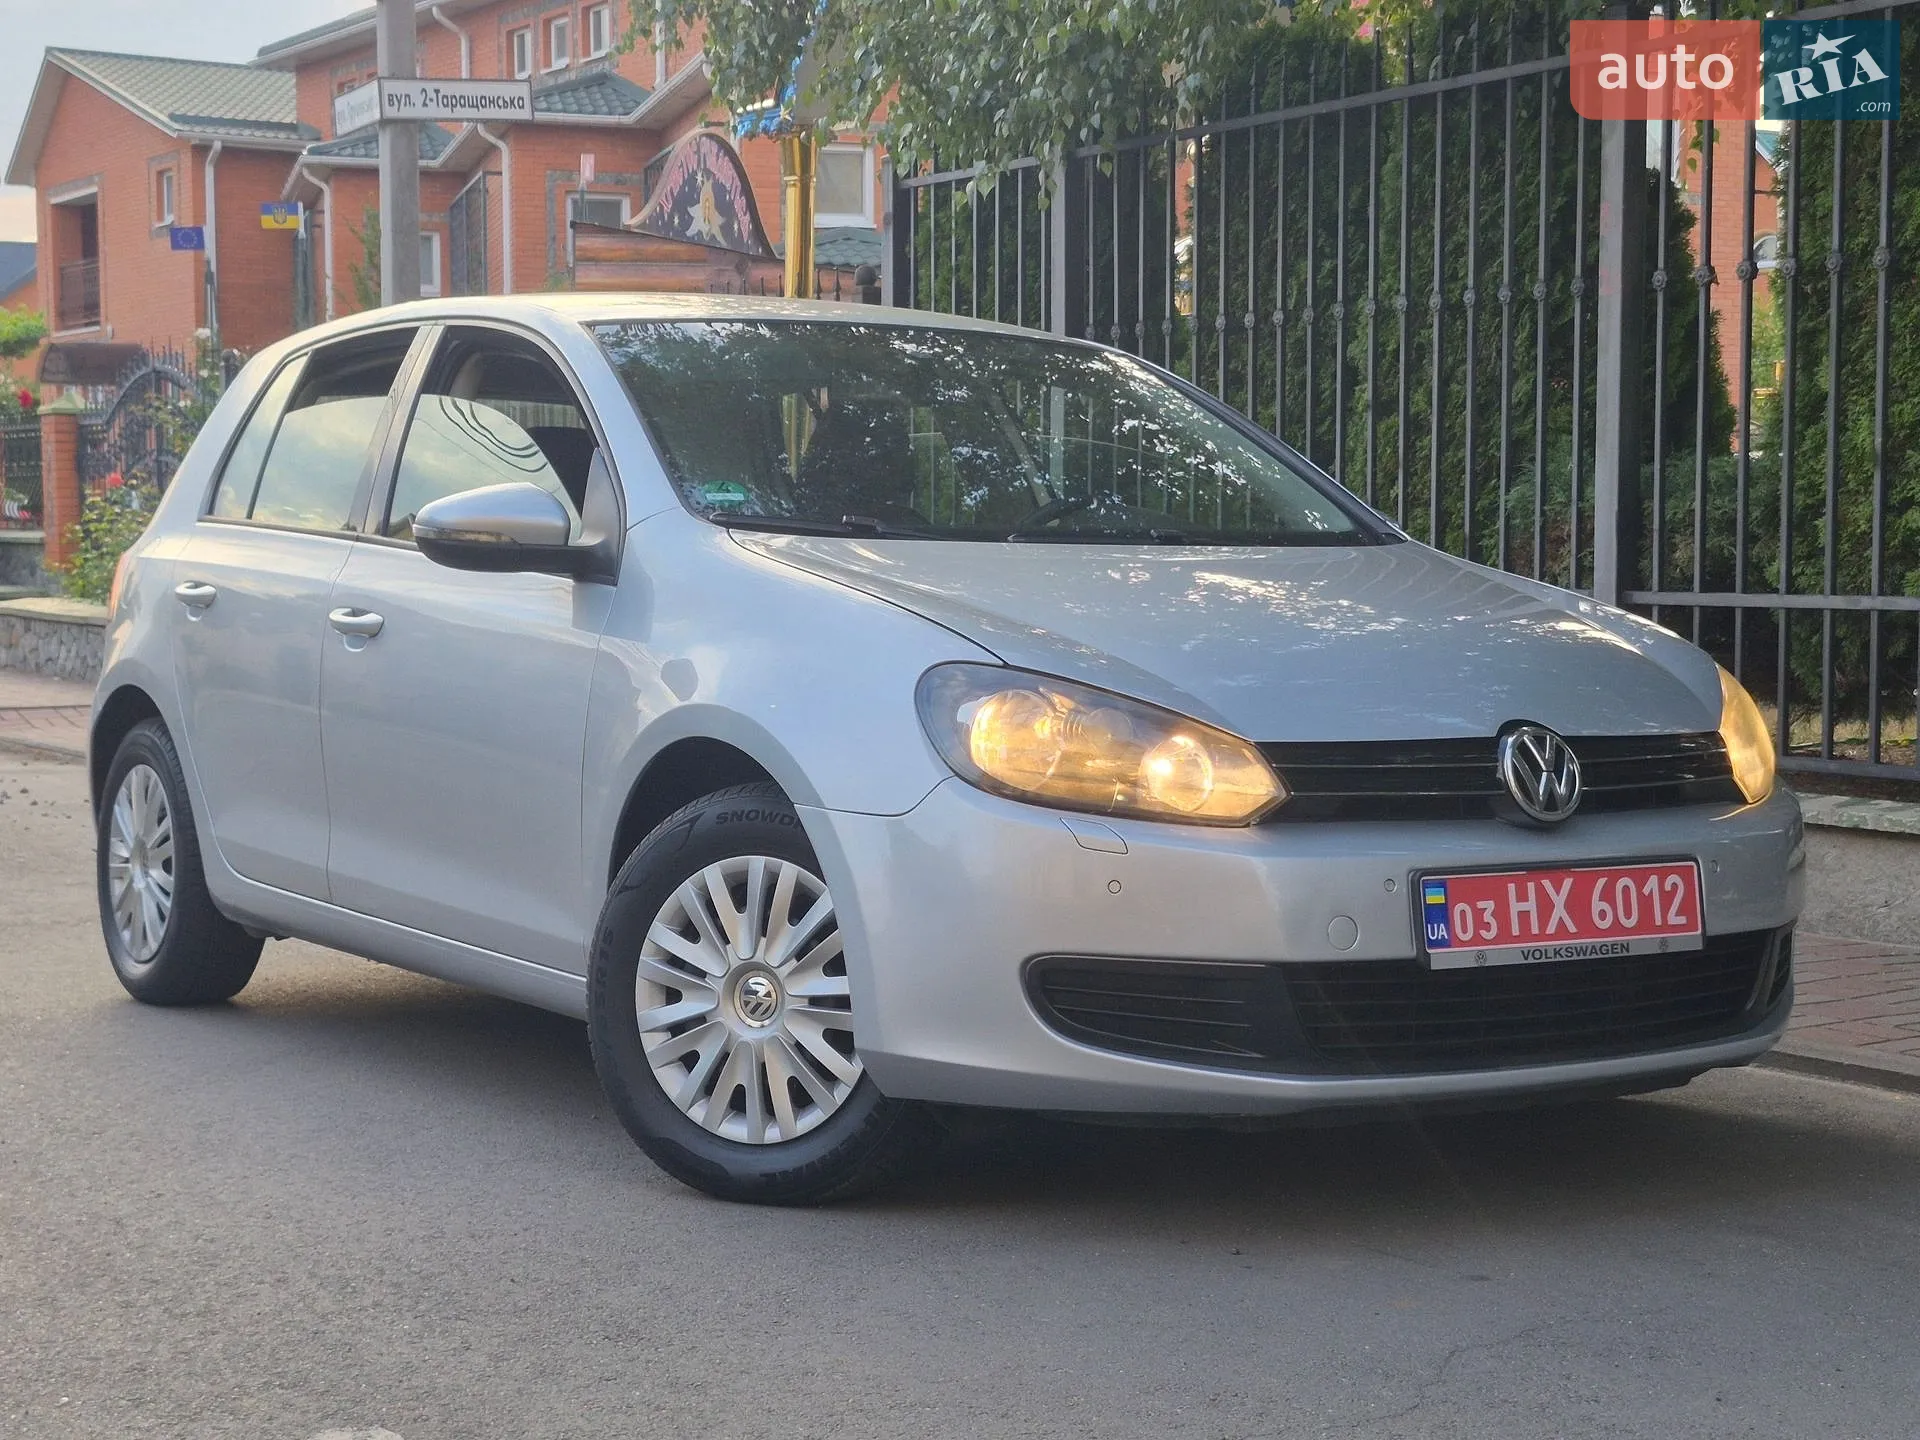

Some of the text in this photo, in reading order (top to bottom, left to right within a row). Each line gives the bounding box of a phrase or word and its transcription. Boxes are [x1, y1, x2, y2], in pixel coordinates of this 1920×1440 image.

[387, 93, 415, 112] вул.
[420, 87, 525, 112] 2-Таращанська
[716, 808, 798, 828] SNOWD
[1427, 873, 1688, 941] UA 03 HX 6012
[1520, 942, 1630, 961] VOLKSWAGEN
